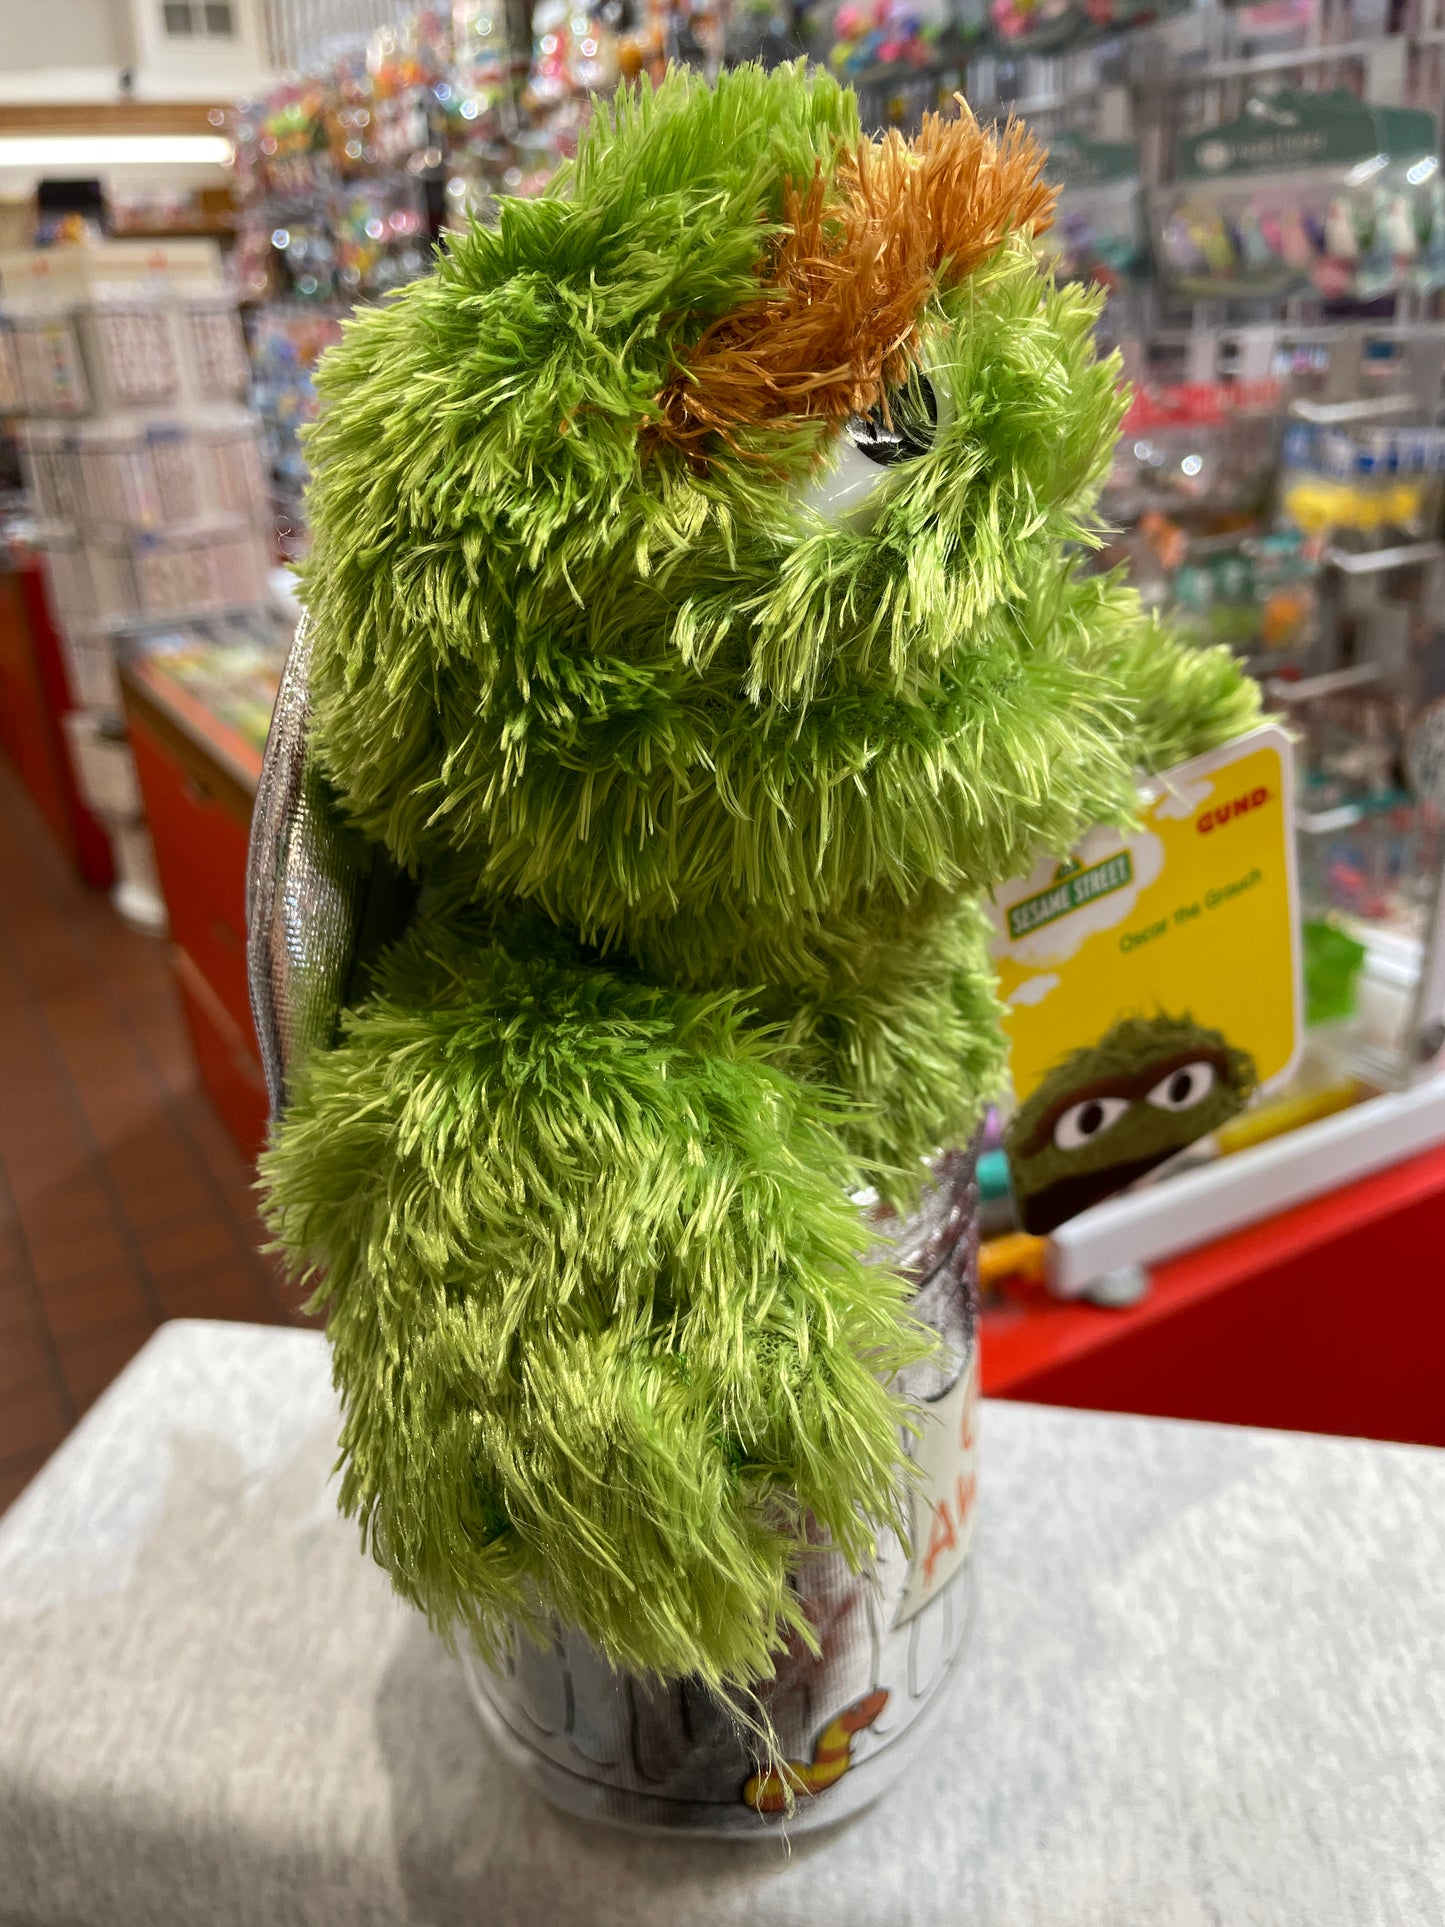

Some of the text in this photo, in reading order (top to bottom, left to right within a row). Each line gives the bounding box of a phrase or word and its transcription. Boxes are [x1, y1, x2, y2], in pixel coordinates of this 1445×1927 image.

[1196, 787, 1268, 836] GUND
[1011, 855, 1129, 936] SESAME STREET
[1119, 868, 1262, 954] Oscar the Grouch
